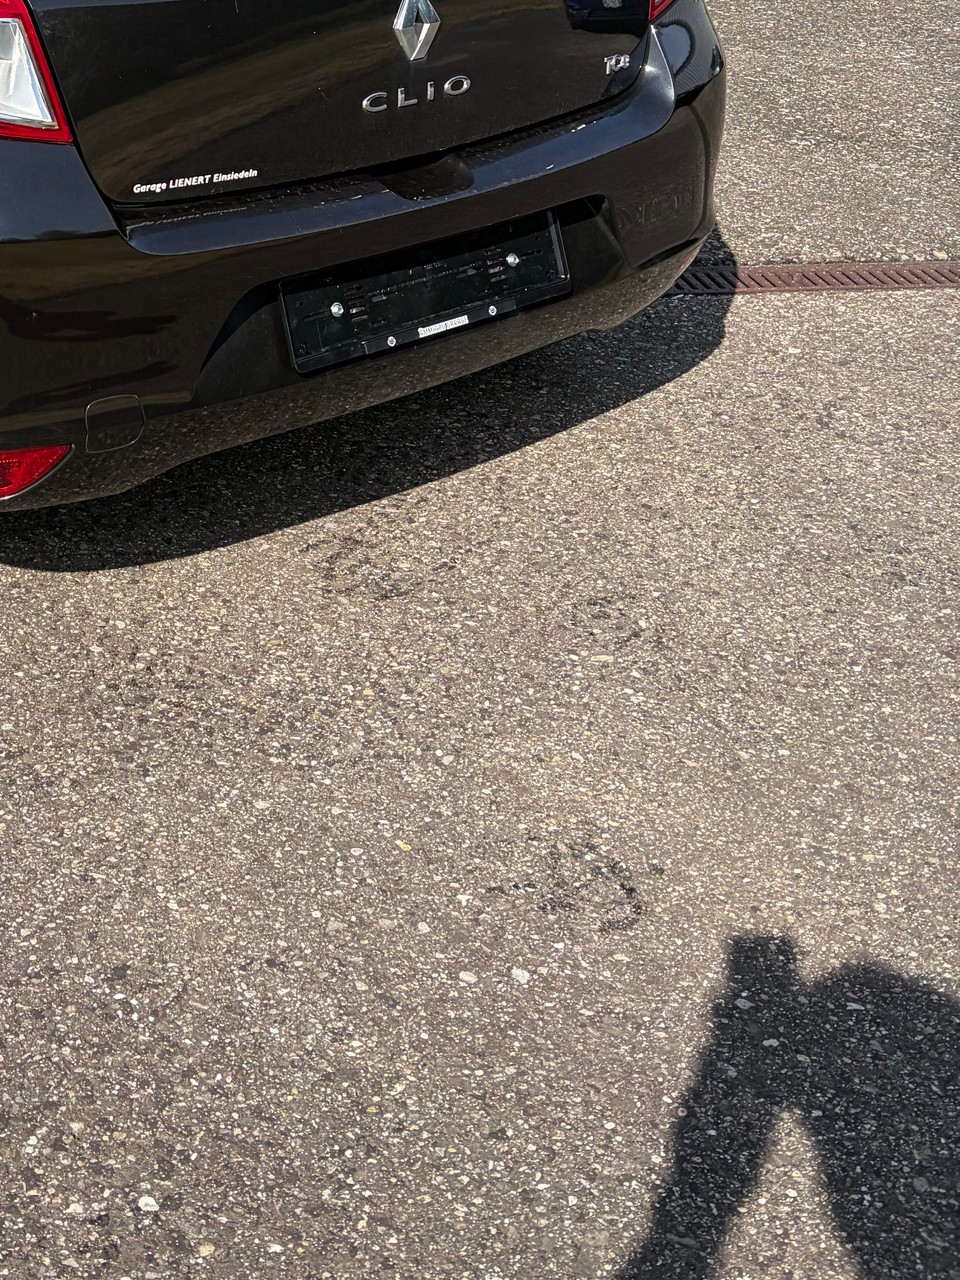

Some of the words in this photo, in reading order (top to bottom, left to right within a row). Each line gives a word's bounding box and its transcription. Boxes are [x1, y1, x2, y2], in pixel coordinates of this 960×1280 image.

[362, 75, 471, 112] CLIO
[133, 181, 167, 193] Garage
[169, 174, 211, 189] LIENERT
[212, 168, 258, 183] Einsiedeln
